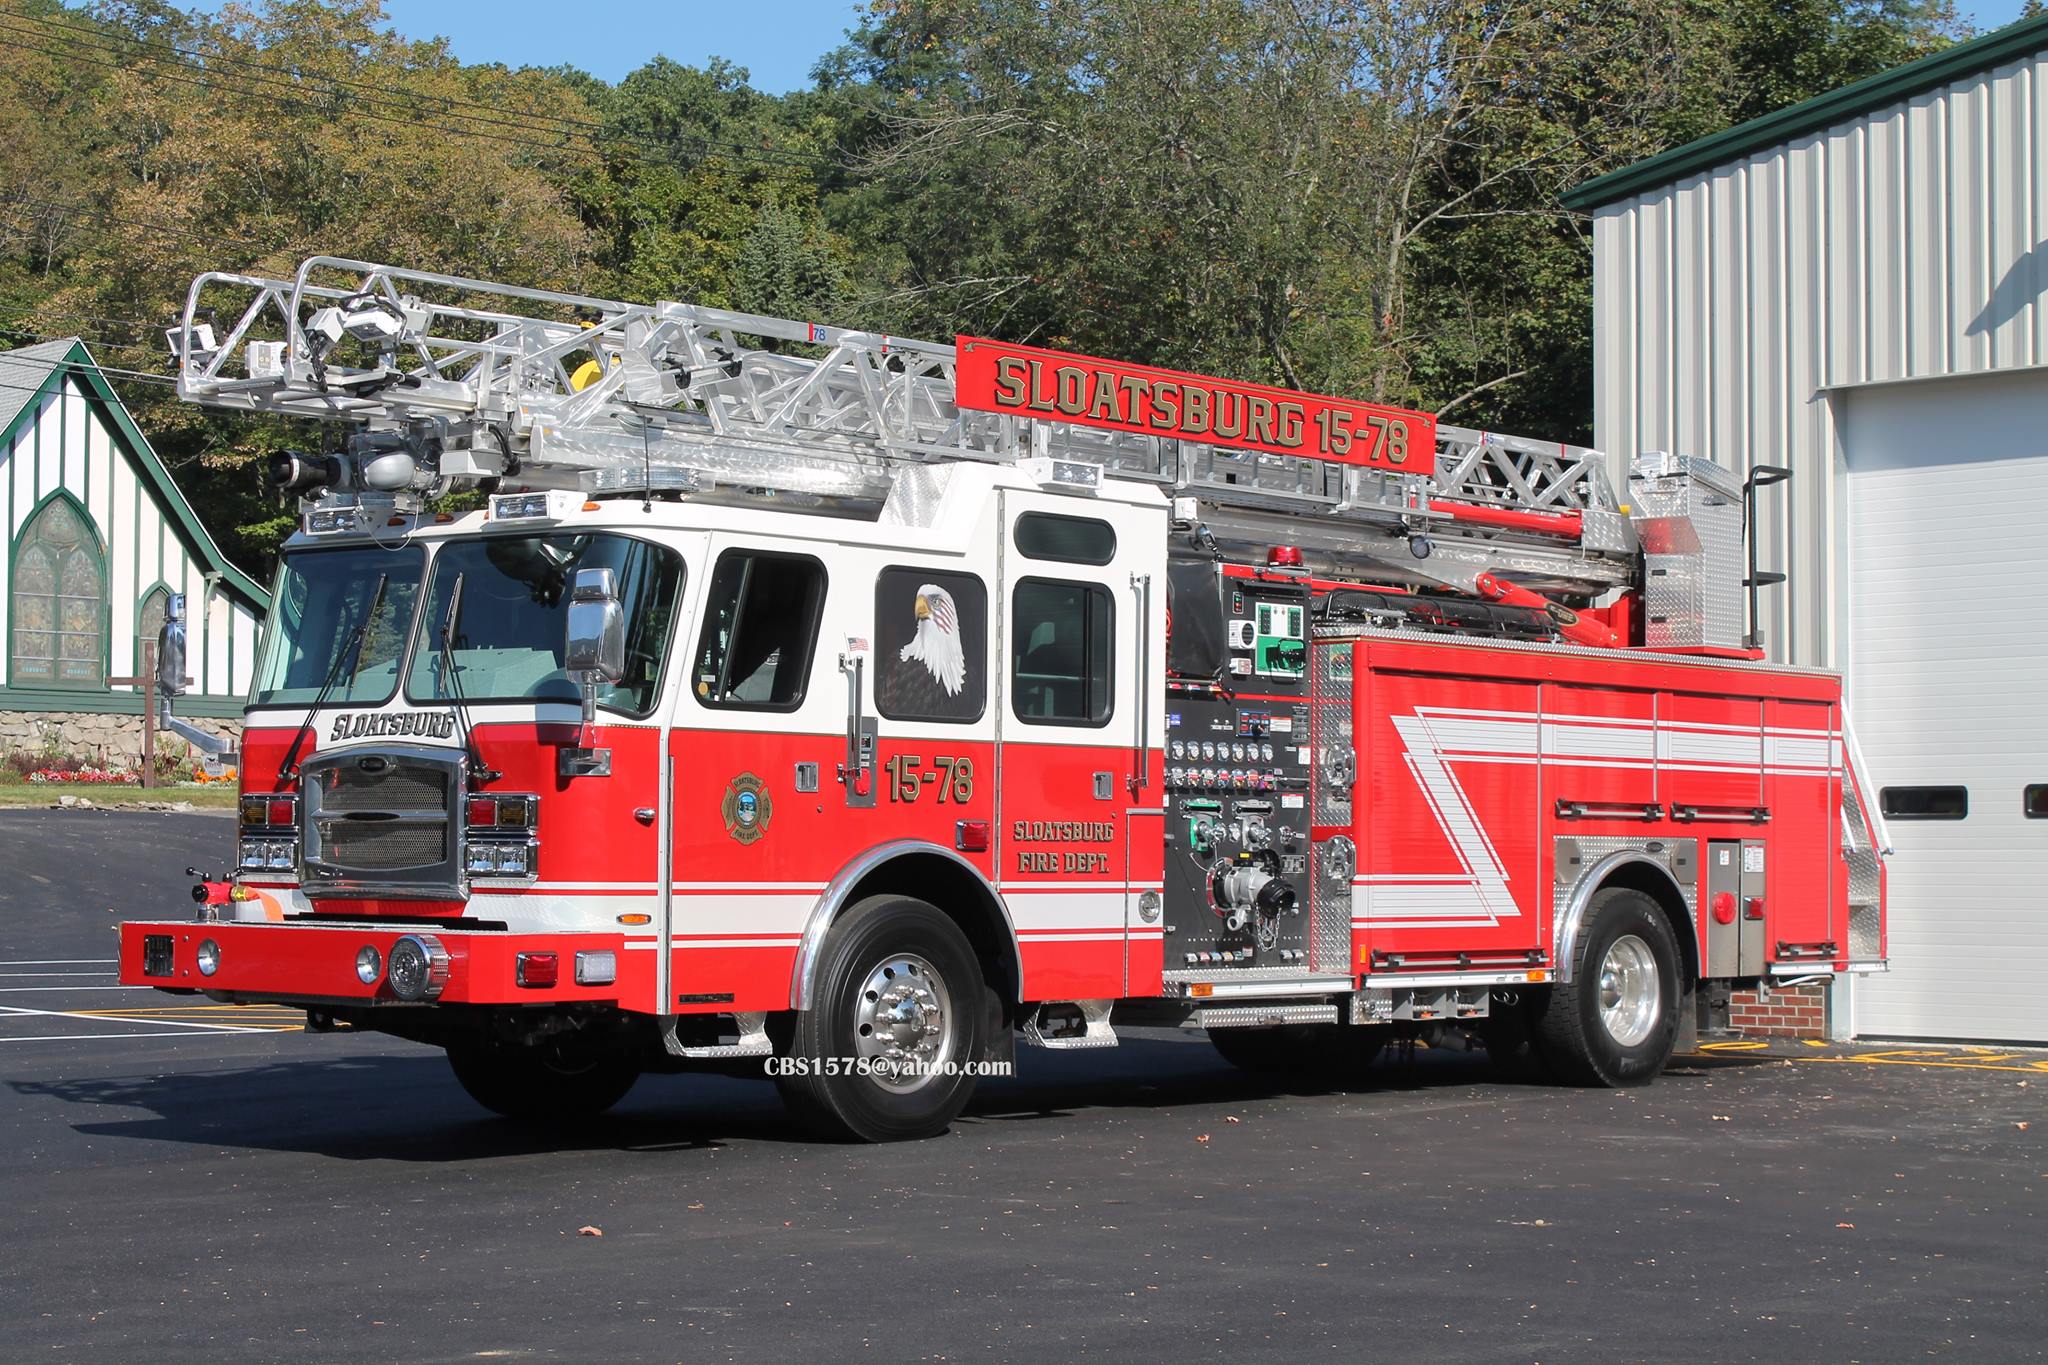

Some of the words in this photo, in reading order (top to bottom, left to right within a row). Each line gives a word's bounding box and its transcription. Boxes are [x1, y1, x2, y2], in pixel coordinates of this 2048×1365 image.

[813, 328, 826, 341] 78
[995, 356, 1305, 448] SLOATSBURG
[1315, 408, 1409, 464] 15-78
[331, 712, 456, 741] SLOATSBURG
[885, 754, 973, 804] 15-78
[1013, 820, 1114, 842] SLOATSBURG
[1018, 851, 1059, 873] FIRE
[1063, 852, 1110, 873] DEPT.
